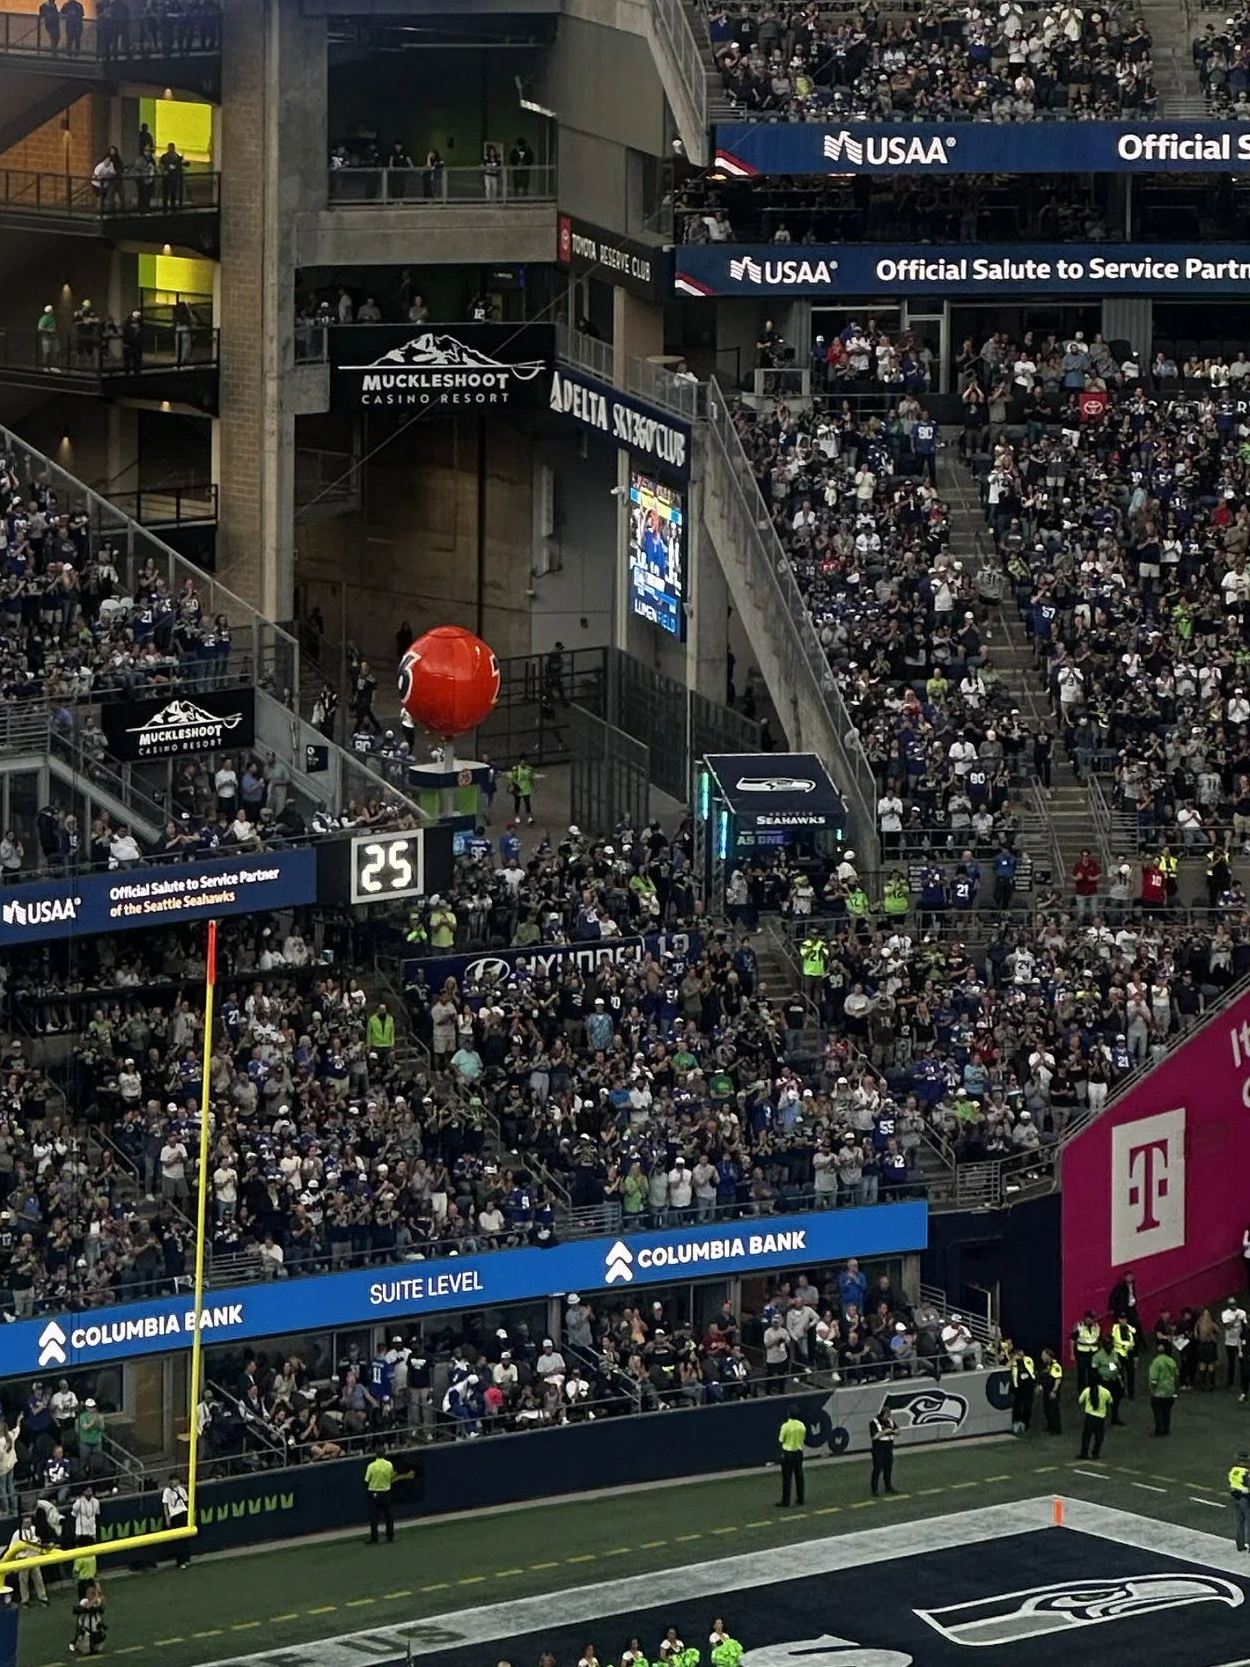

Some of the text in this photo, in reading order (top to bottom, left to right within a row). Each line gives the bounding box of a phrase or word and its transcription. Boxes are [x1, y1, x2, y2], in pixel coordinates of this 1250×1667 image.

[1118, 133, 1230, 161] Official
[600, 244, 630, 274] RESERVE
[632, 256, 650, 282] CLUB
[876, 258, 967, 281] Official
[973, 258, 1049, 280] Salute
[1056, 260, 1084, 279] to
[1089, 257, 1180, 280] Service
[362, 373, 509, 390] MUCKLESHOOT
[361, 392, 509, 404] CASINO RESORT
[564, 379, 608, 431] DELTA
[656, 424, 685, 467] CLUB
[139, 724, 223, 746] MUCKLESHOOT
[139, 738, 222, 756] CASINO RESORT
[757, 816, 825, 825] SEAHAWKS
[361, 841, 412, 892] 25
[110, 868, 280, 901] Official Salute to Service Partner
[956, 883, 970, 898] 21
[110, 890, 235, 918] of the Seattle Seahawks
[1118, 1053, 1130, 1068] 21
[637, 1230, 806, 1269] COLUMBIA BANK
[370, 1271, 483, 1305] SUITE LEVEL
[72, 1303, 244, 1349] COLUMBIA BANK
[372, 1366, 383, 1384] 11
